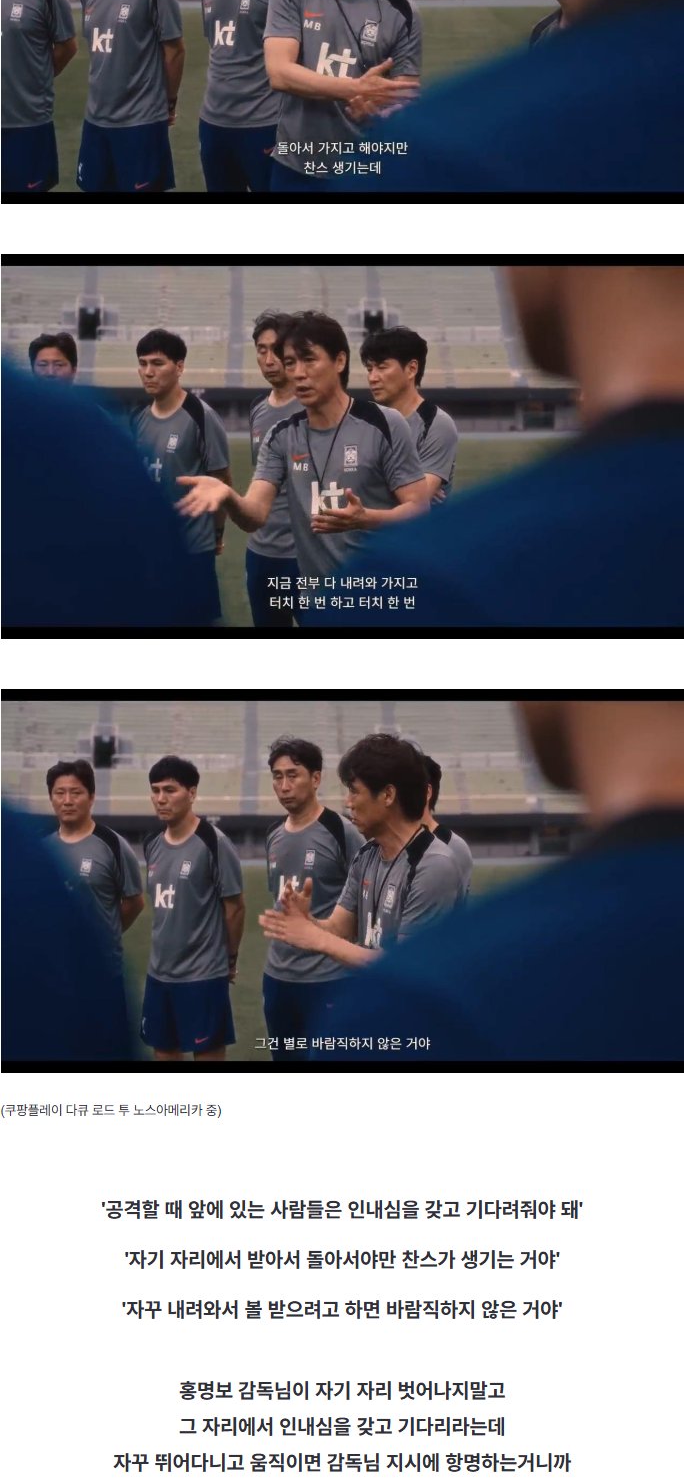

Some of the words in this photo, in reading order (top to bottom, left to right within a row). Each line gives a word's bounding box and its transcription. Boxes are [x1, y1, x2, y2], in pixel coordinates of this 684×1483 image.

[92, 27, 114, 53] kt
[214, 20, 236, 46] kt
[316, 41, 357, 79] kt
[311, 481, 344, 515] kt
[154, 883, 176, 909] kt
